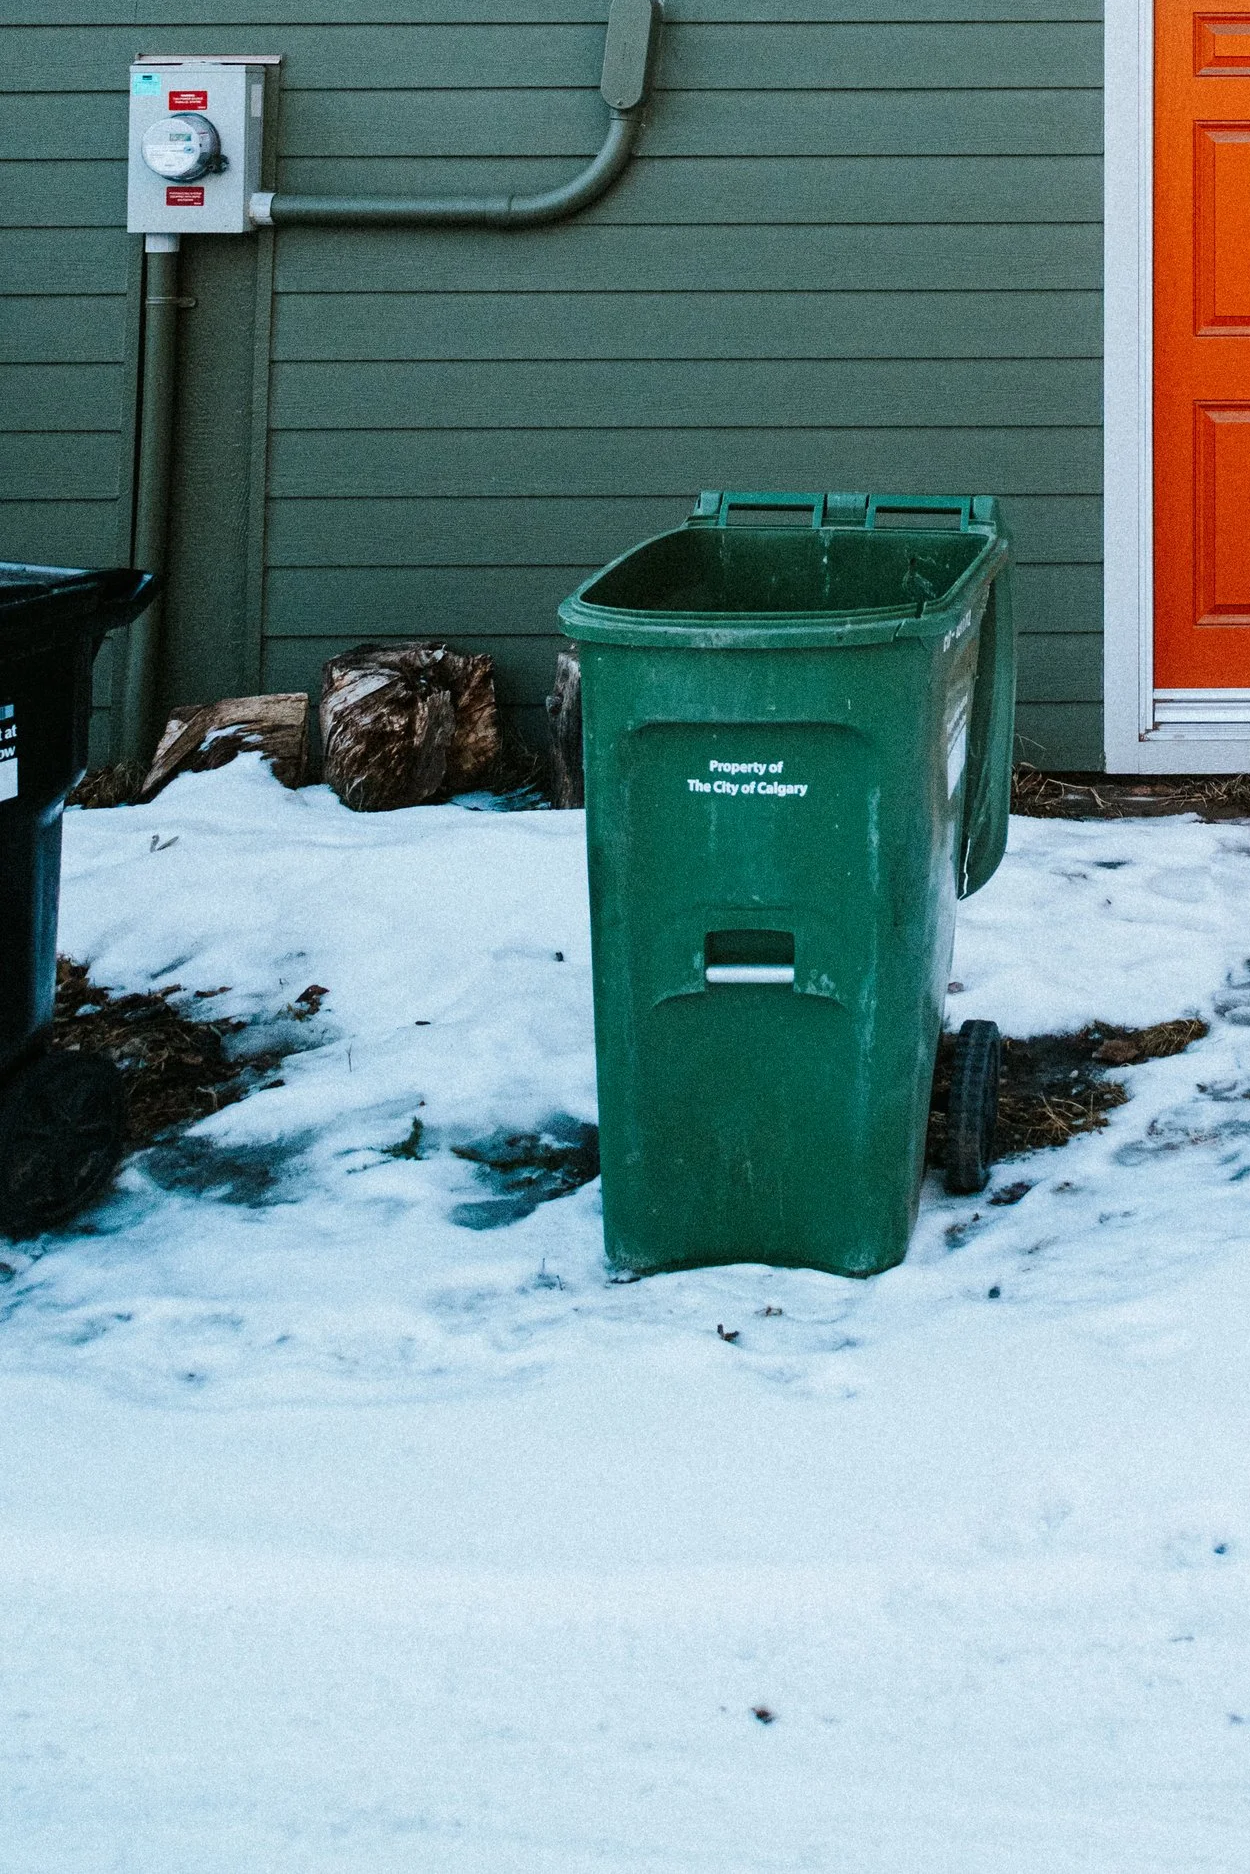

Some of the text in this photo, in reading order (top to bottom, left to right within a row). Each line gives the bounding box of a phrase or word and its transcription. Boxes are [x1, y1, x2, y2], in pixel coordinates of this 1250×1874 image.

[5, 724, 17, 739] at
[709, 760, 783, 775] Property of
[687, 779, 808, 797] The City of Calgary
